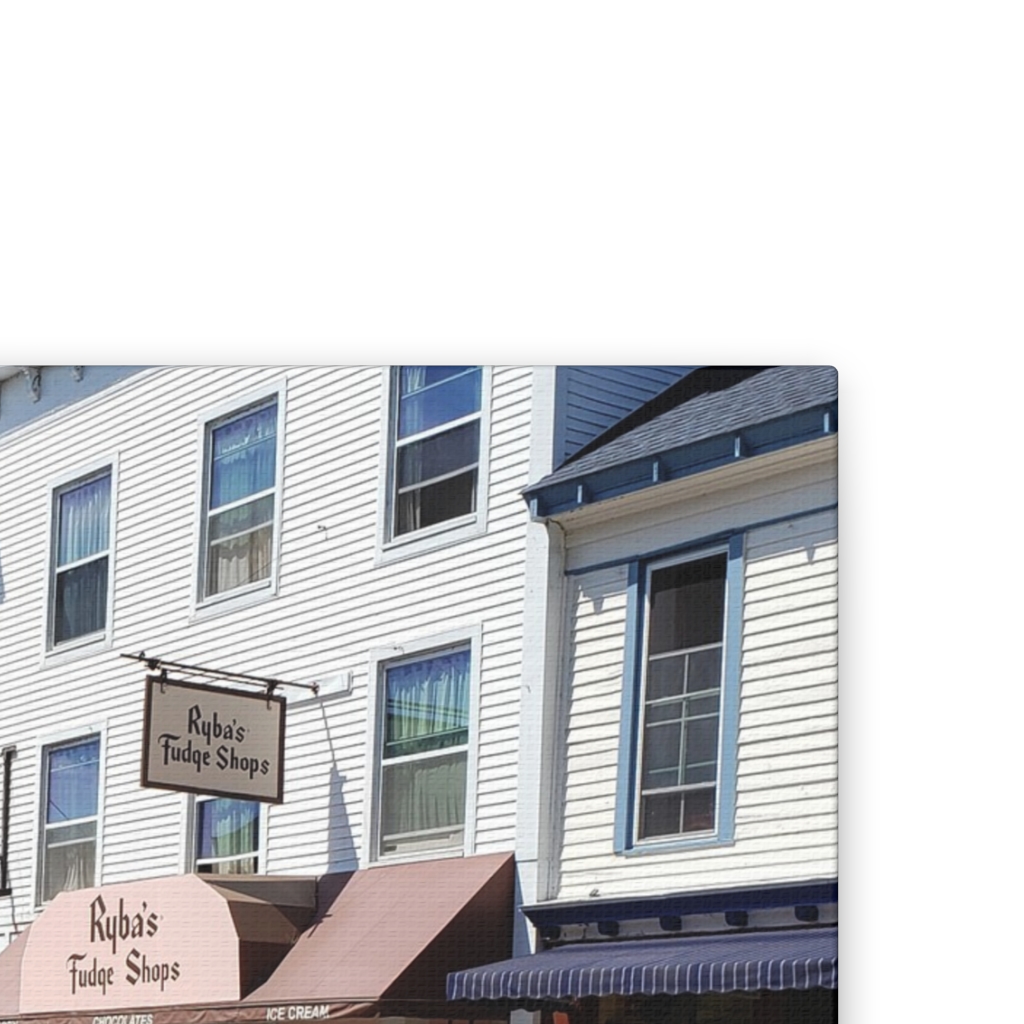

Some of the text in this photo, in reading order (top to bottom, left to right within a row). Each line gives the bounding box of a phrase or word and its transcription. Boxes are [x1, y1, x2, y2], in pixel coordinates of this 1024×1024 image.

[187, 704, 246, 746] Ryba's
[157, 733, 270, 780] Fudge Shops
[89, 894, 159, 954] Ryba's
[65, 947, 181, 995] Fudge Shops
[266, 1004, 330, 1021] ICE CREAM
